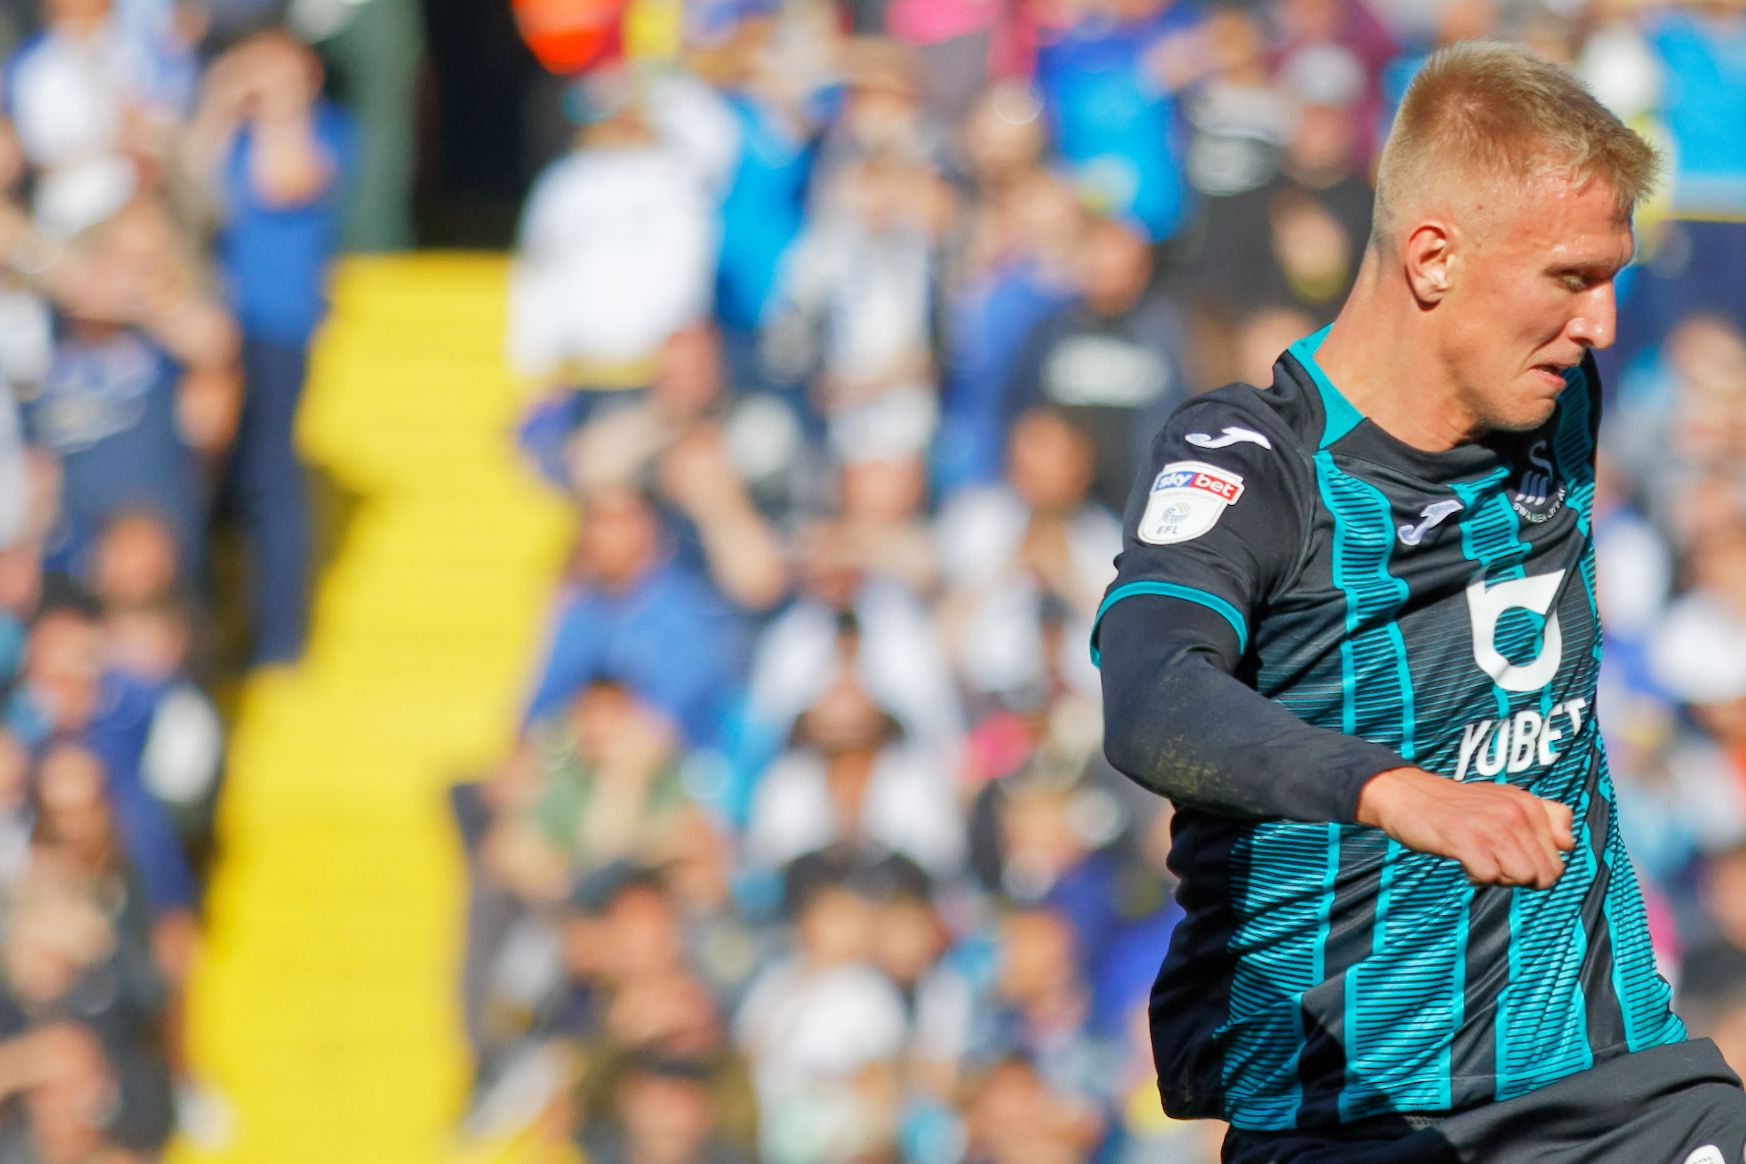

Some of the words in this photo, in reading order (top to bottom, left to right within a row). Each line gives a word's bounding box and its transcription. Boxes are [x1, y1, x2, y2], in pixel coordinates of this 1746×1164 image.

[1157, 473, 1192, 488] sky
[1195, 473, 1234, 497] bet
[1156, 525, 1179, 535] EFL
